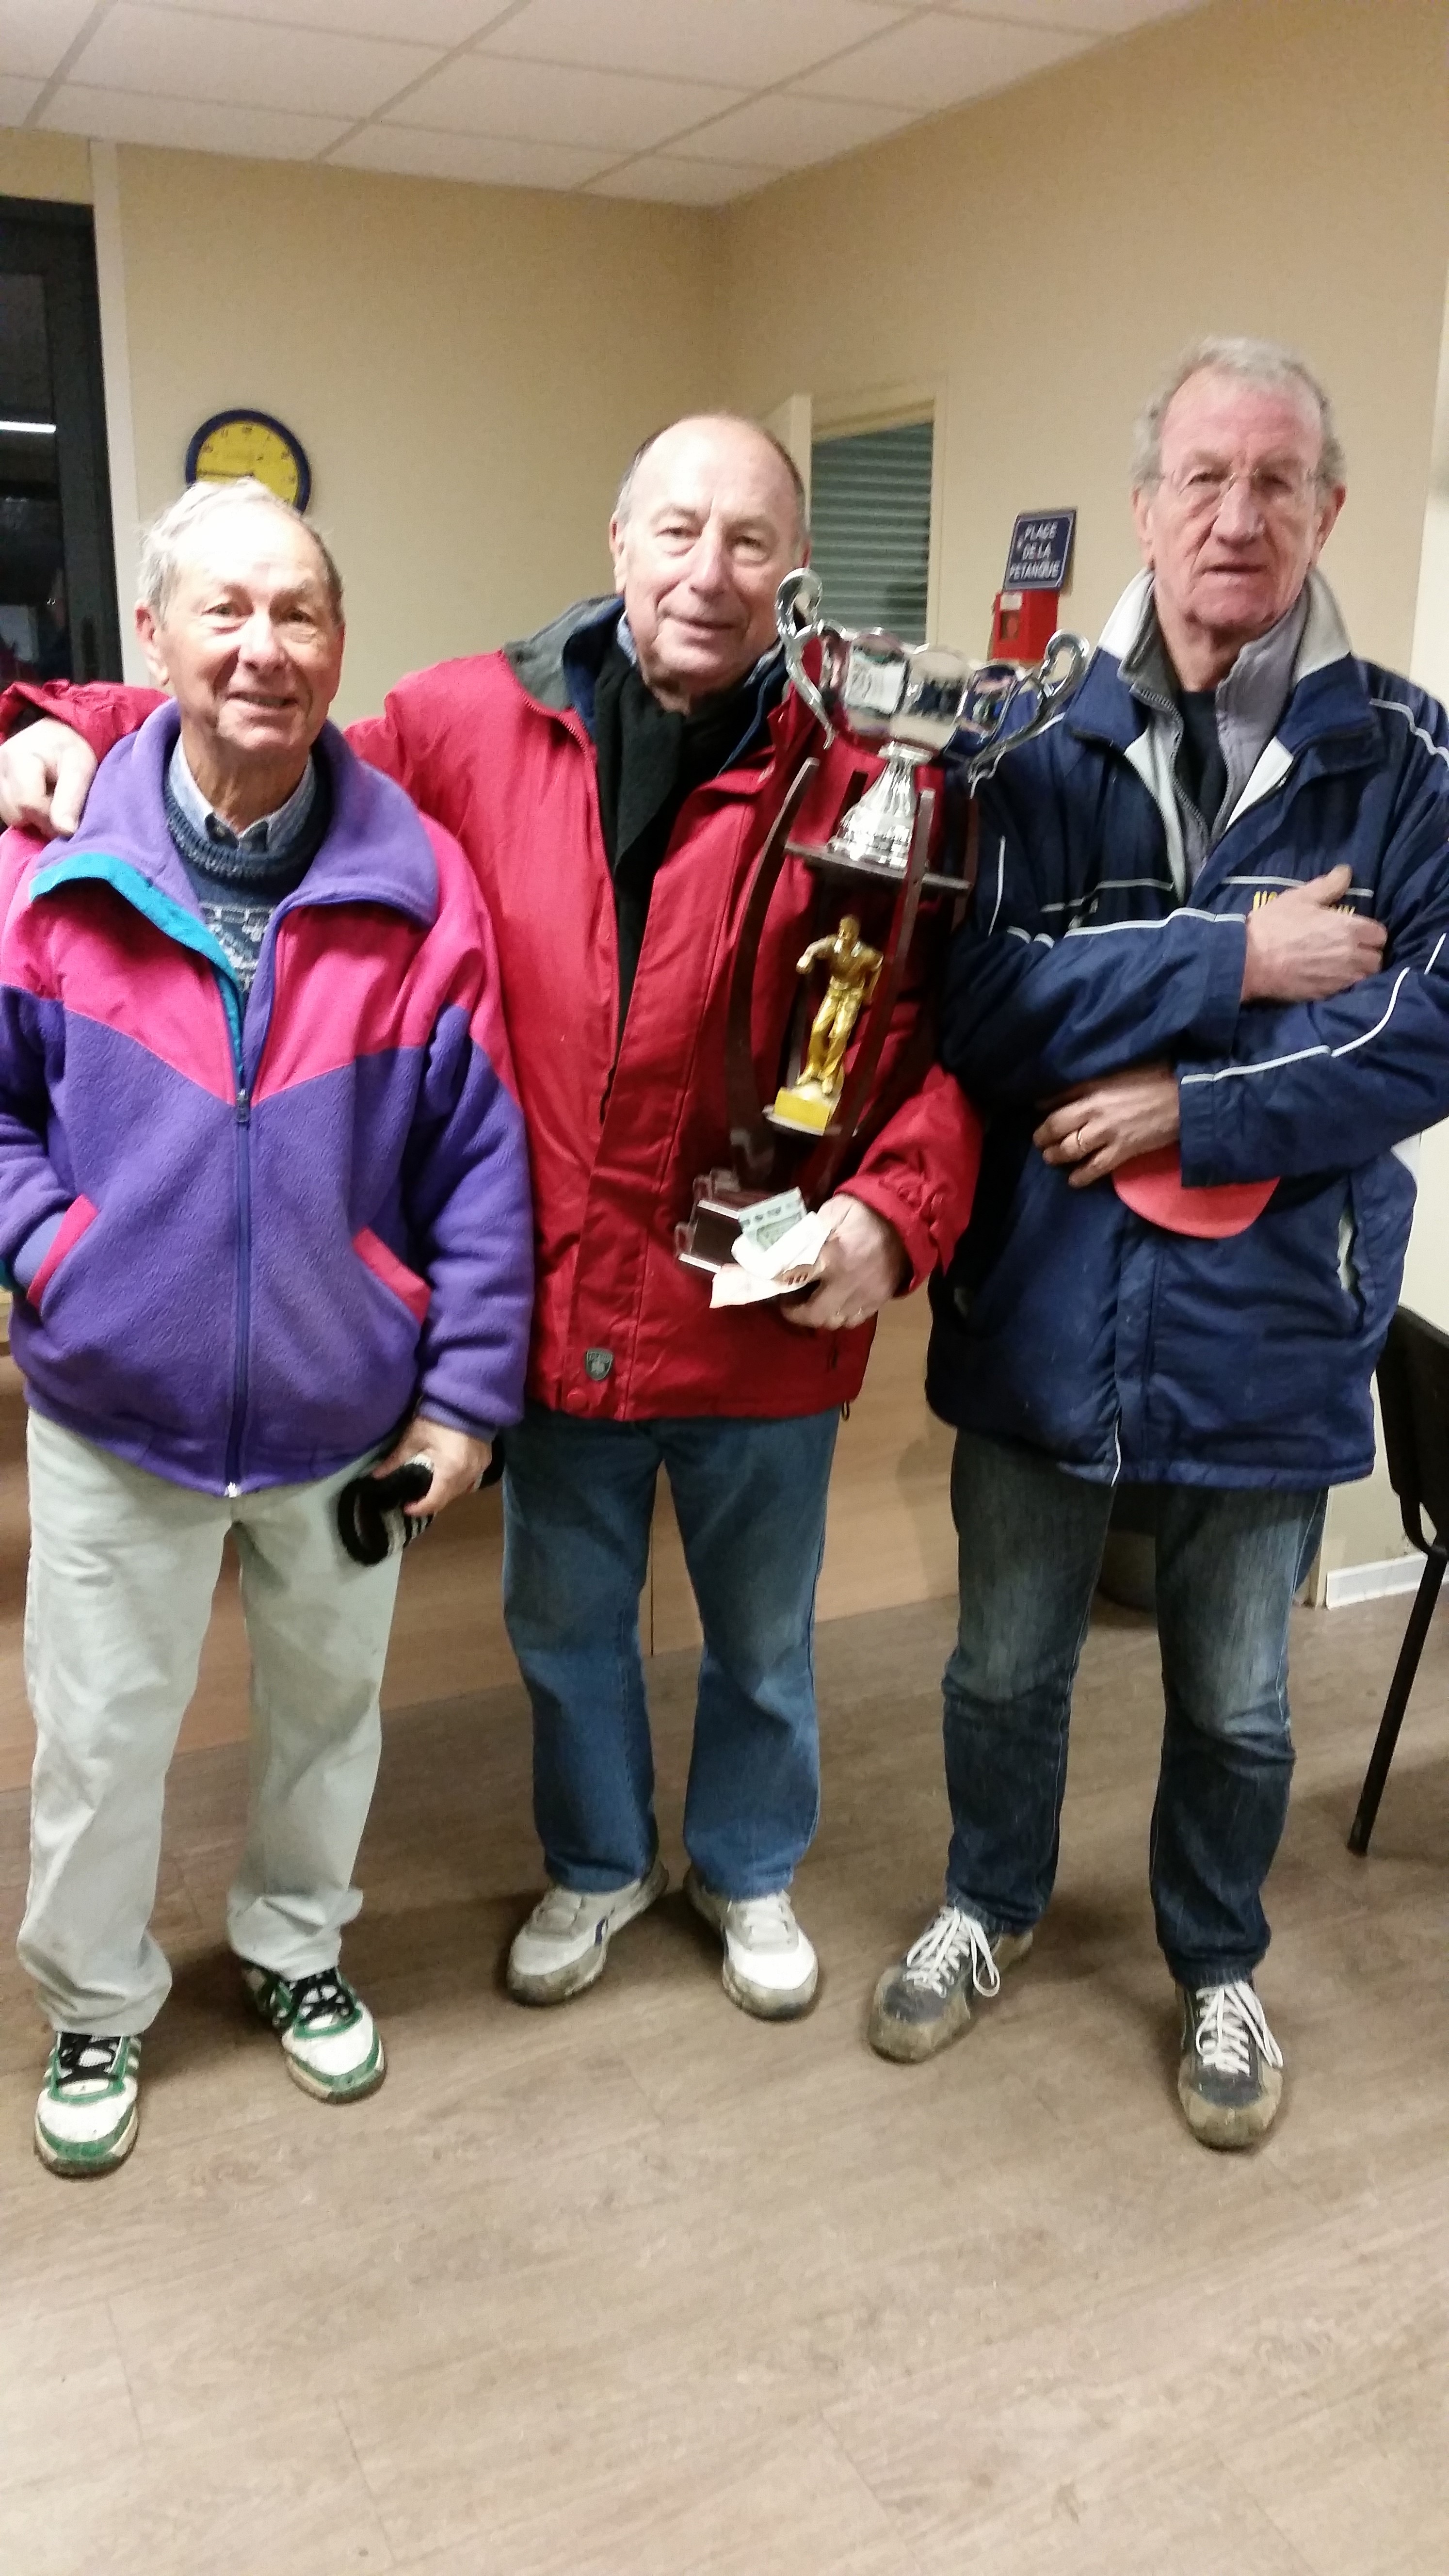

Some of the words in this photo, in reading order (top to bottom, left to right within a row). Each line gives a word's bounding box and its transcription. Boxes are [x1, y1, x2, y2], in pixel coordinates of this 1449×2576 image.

[1024, 521, 1058, 540] PLACE
[1022, 542, 1037, 560] DE
[1038, 541, 1051, 559] LA
